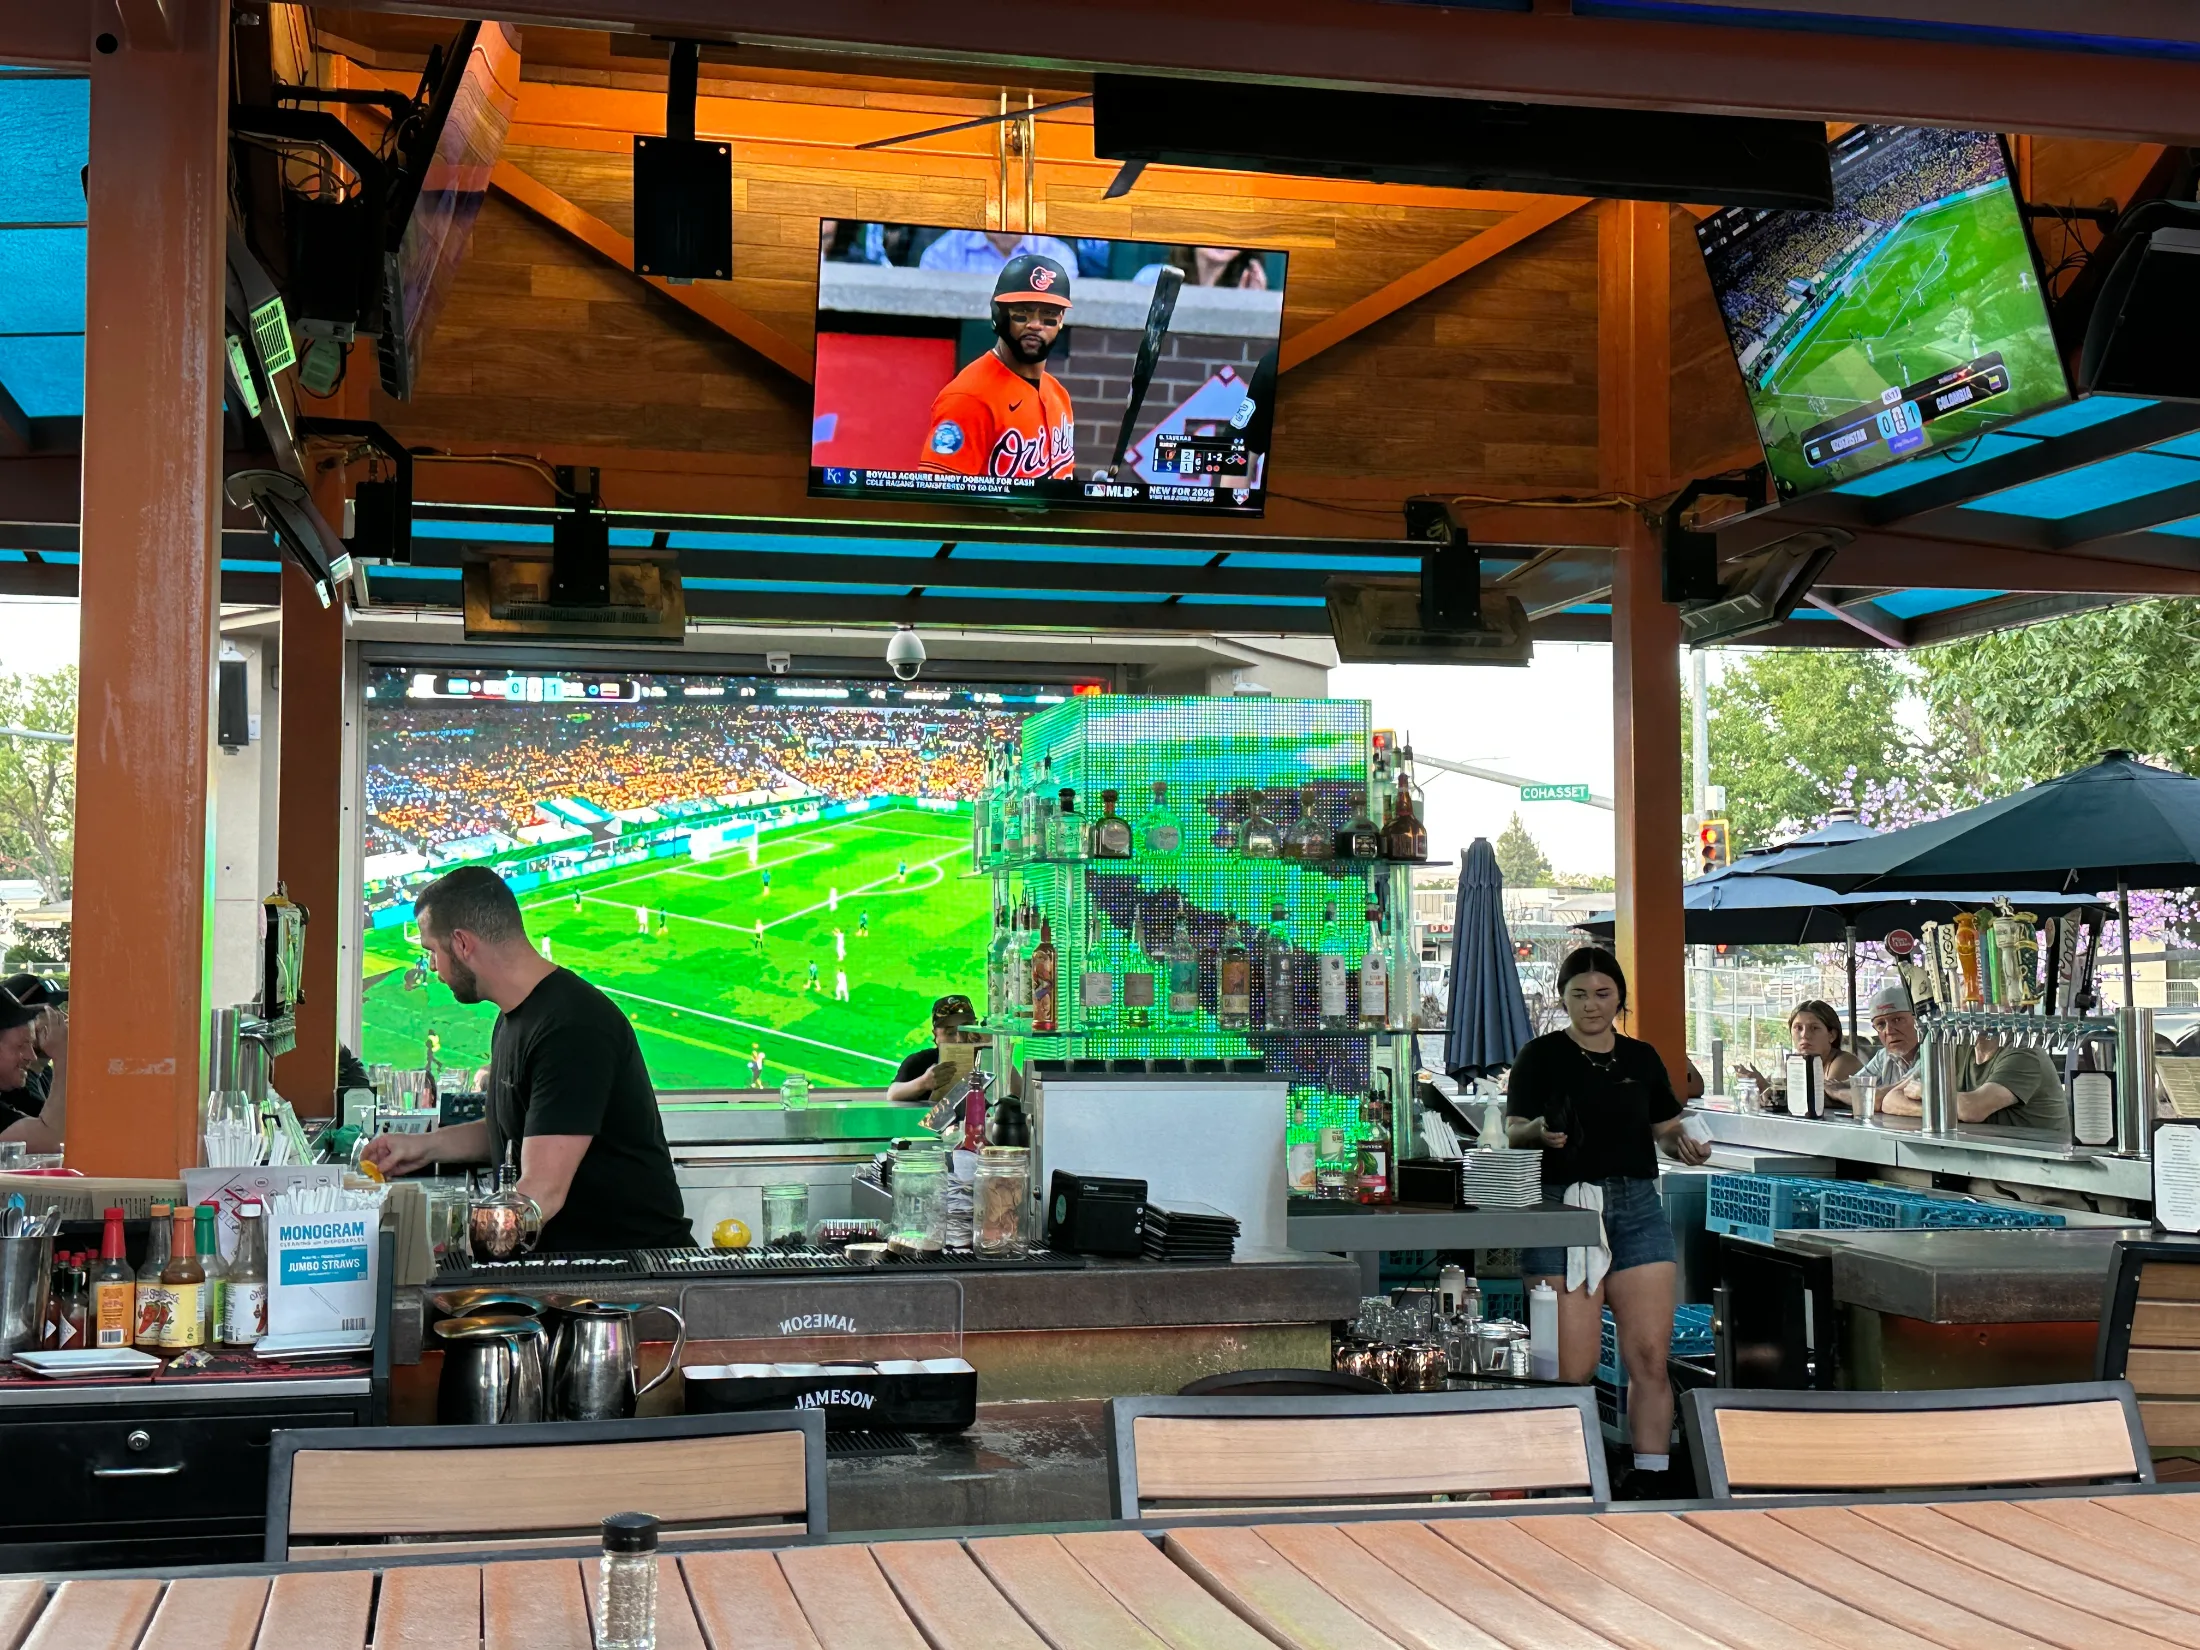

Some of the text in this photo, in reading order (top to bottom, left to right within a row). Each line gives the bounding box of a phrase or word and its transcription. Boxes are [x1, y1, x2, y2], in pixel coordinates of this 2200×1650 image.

[1881, 415, 1891, 434] 0
[1184, 451, 1191, 460] 2
[1207, 452, 1223, 462] 1-2
[997, 478, 1012, 486] FOR
[1013, 478, 1035, 487] CASH
[1105, 485, 1140, 498] MLB+
[1149, 485, 1215, 497] NEW FOR 2026
[1522, 785, 1588, 800] COHASSET
[280, 1221, 365, 1241] MONOGRAM
[288, 1258, 361, 1272] JUMBO STRAWS
[795, 1389, 874, 1410] JAMESON
